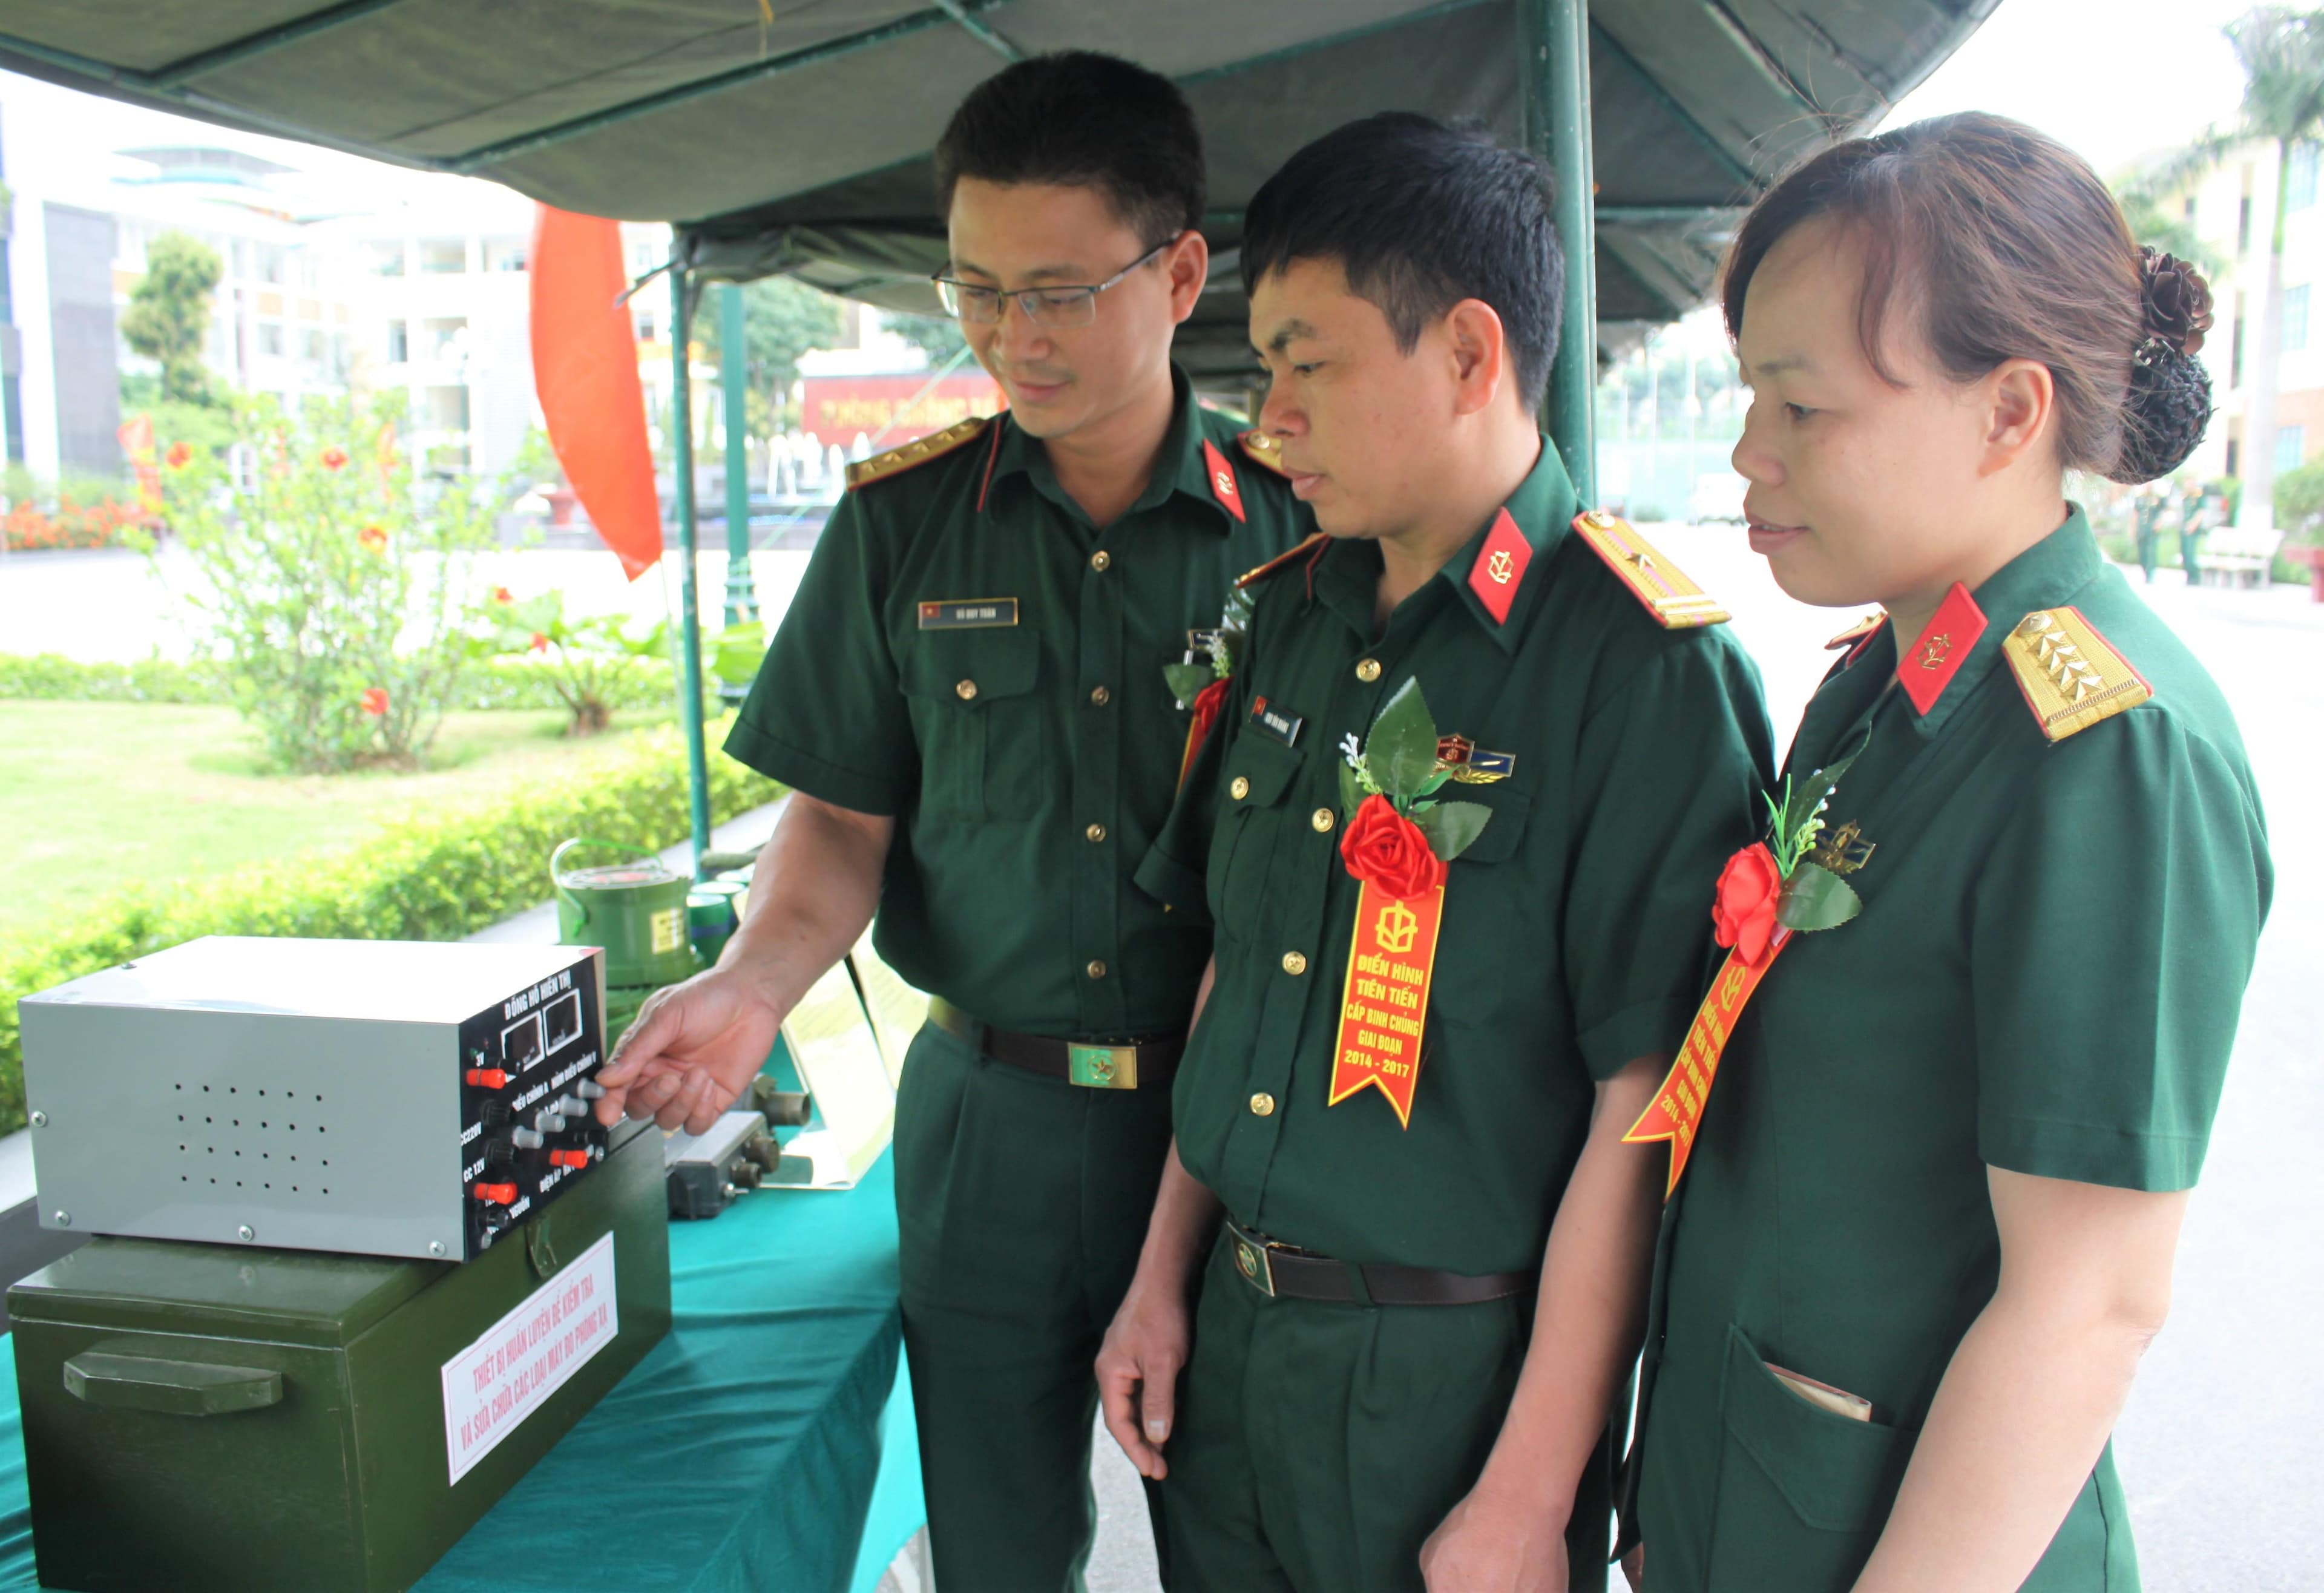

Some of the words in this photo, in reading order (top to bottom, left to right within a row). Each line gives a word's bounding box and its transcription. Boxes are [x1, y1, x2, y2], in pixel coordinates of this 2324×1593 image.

[1391, 962, 1424, 986] HÌNH
[1357, 979, 1386, 1001] TIÊN
[1389, 985, 1418, 1010] TIẾN
[1346, 1000, 1366, 1021] CẤP
[1366, 1008, 1388, 1028] BINH
[1389, 1011, 1419, 1037] CHỦNG
[1357, 1030, 1377, 1048] GIAI
[1377, 1034, 1402, 1056] ĐOẠN
[1344, 1049, 1372, 1068] 2014
[1382, 1059, 1410, 1077] 2017
[473, 1348, 494, 1394] THIẾT
[496, 1346, 506, 1376] BỊ
[506, 1322, 528, 1366] HUẤN
[528, 1307, 551, 1347] LUYỆN
[562, 1278, 580, 1319] KIỂM
[581, 1273, 594, 1302] TRA
[461, 1416, 473, 1451] VÀ
[474, 1398, 491, 1440] SỬA
[514, 1370, 530, 1404] CÁC
[530, 1355, 547, 1390] LOẠI
[548, 1339, 563, 1374] MÁY
